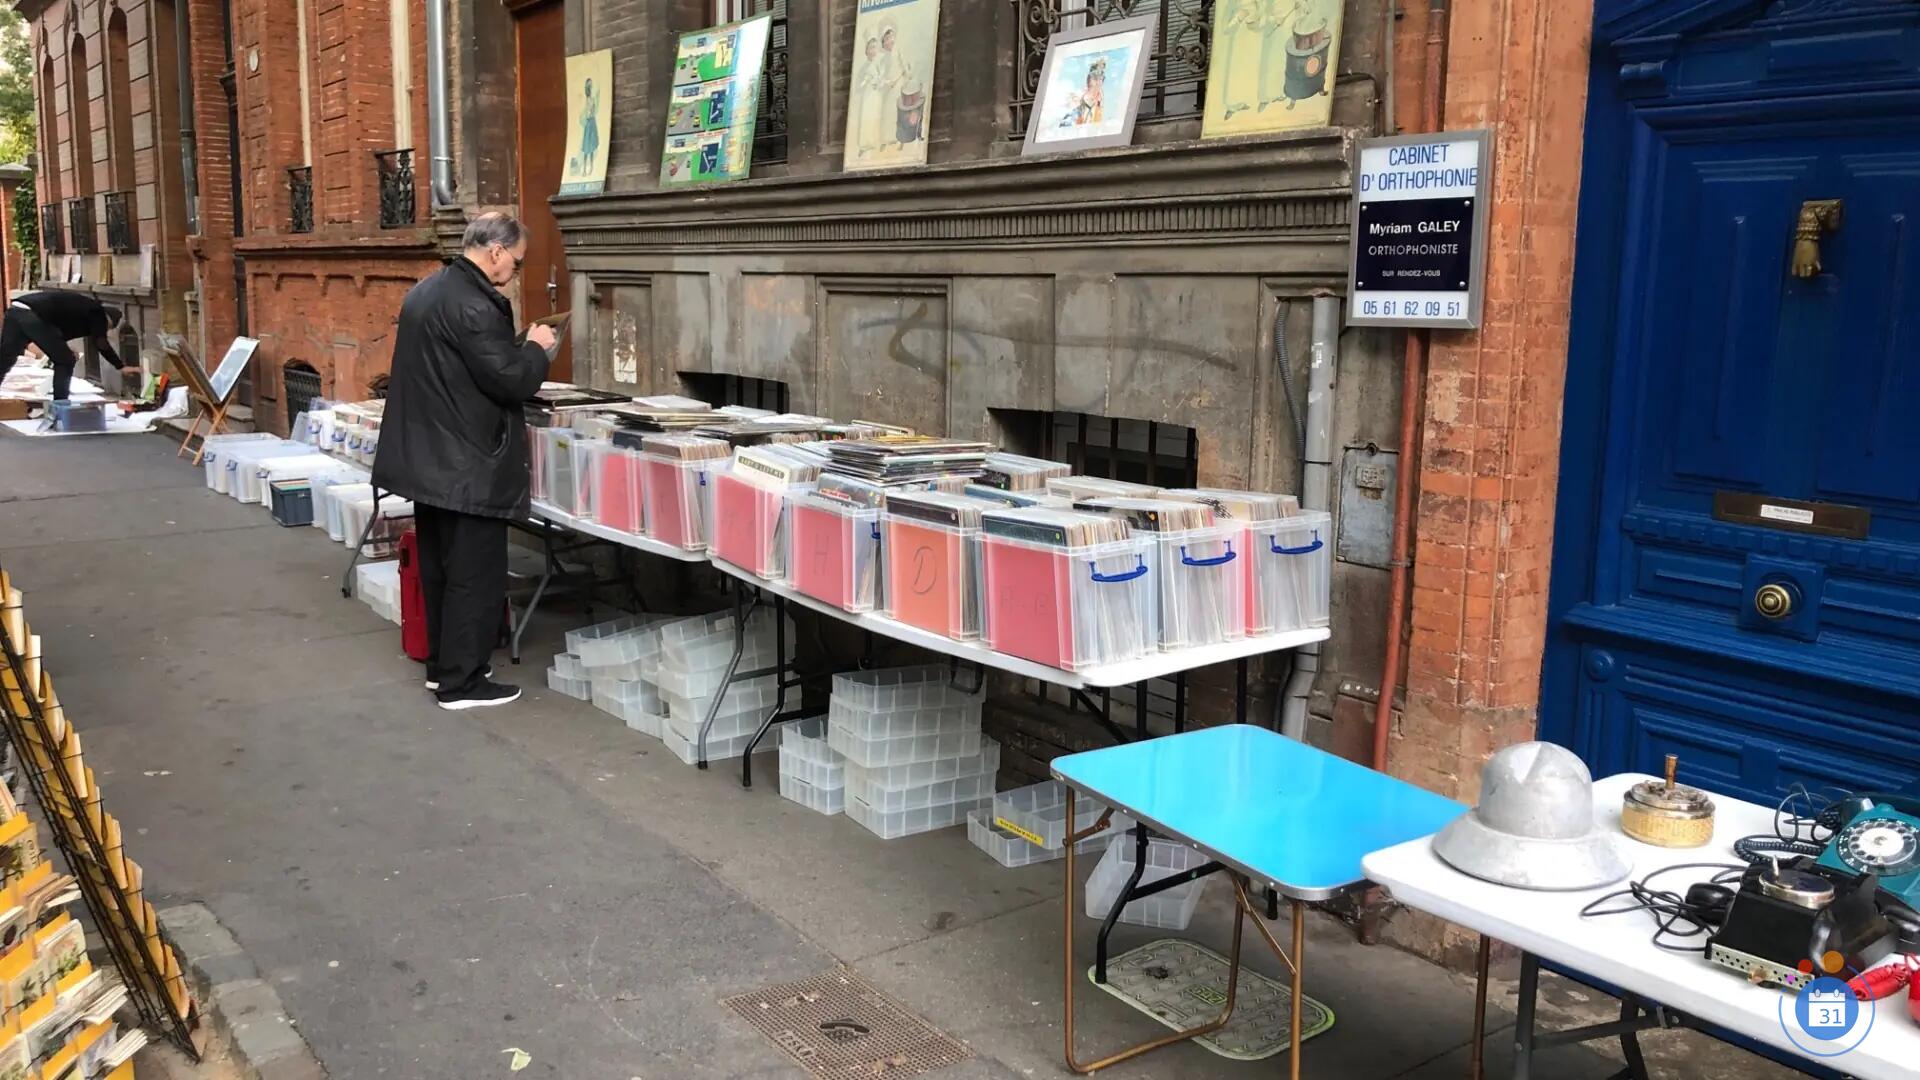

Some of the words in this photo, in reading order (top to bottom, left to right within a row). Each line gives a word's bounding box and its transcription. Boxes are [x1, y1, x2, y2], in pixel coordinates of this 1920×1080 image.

[1389, 144, 1450, 166] CABINET
[1369, 223, 1412, 236] Myriam
[1418, 221, 1461, 233] GALEY
[1368, 243, 1459, 256] ORTHOPHONISTE
[1363, 300, 1378, 315] 05
[1383, 301, 1397, 315] 61
[1404, 301, 1419, 316] 62
[1425, 302, 1440, 316] 09
[1447, 302, 1461, 317] 51
[911, 545, 938, 595] D
